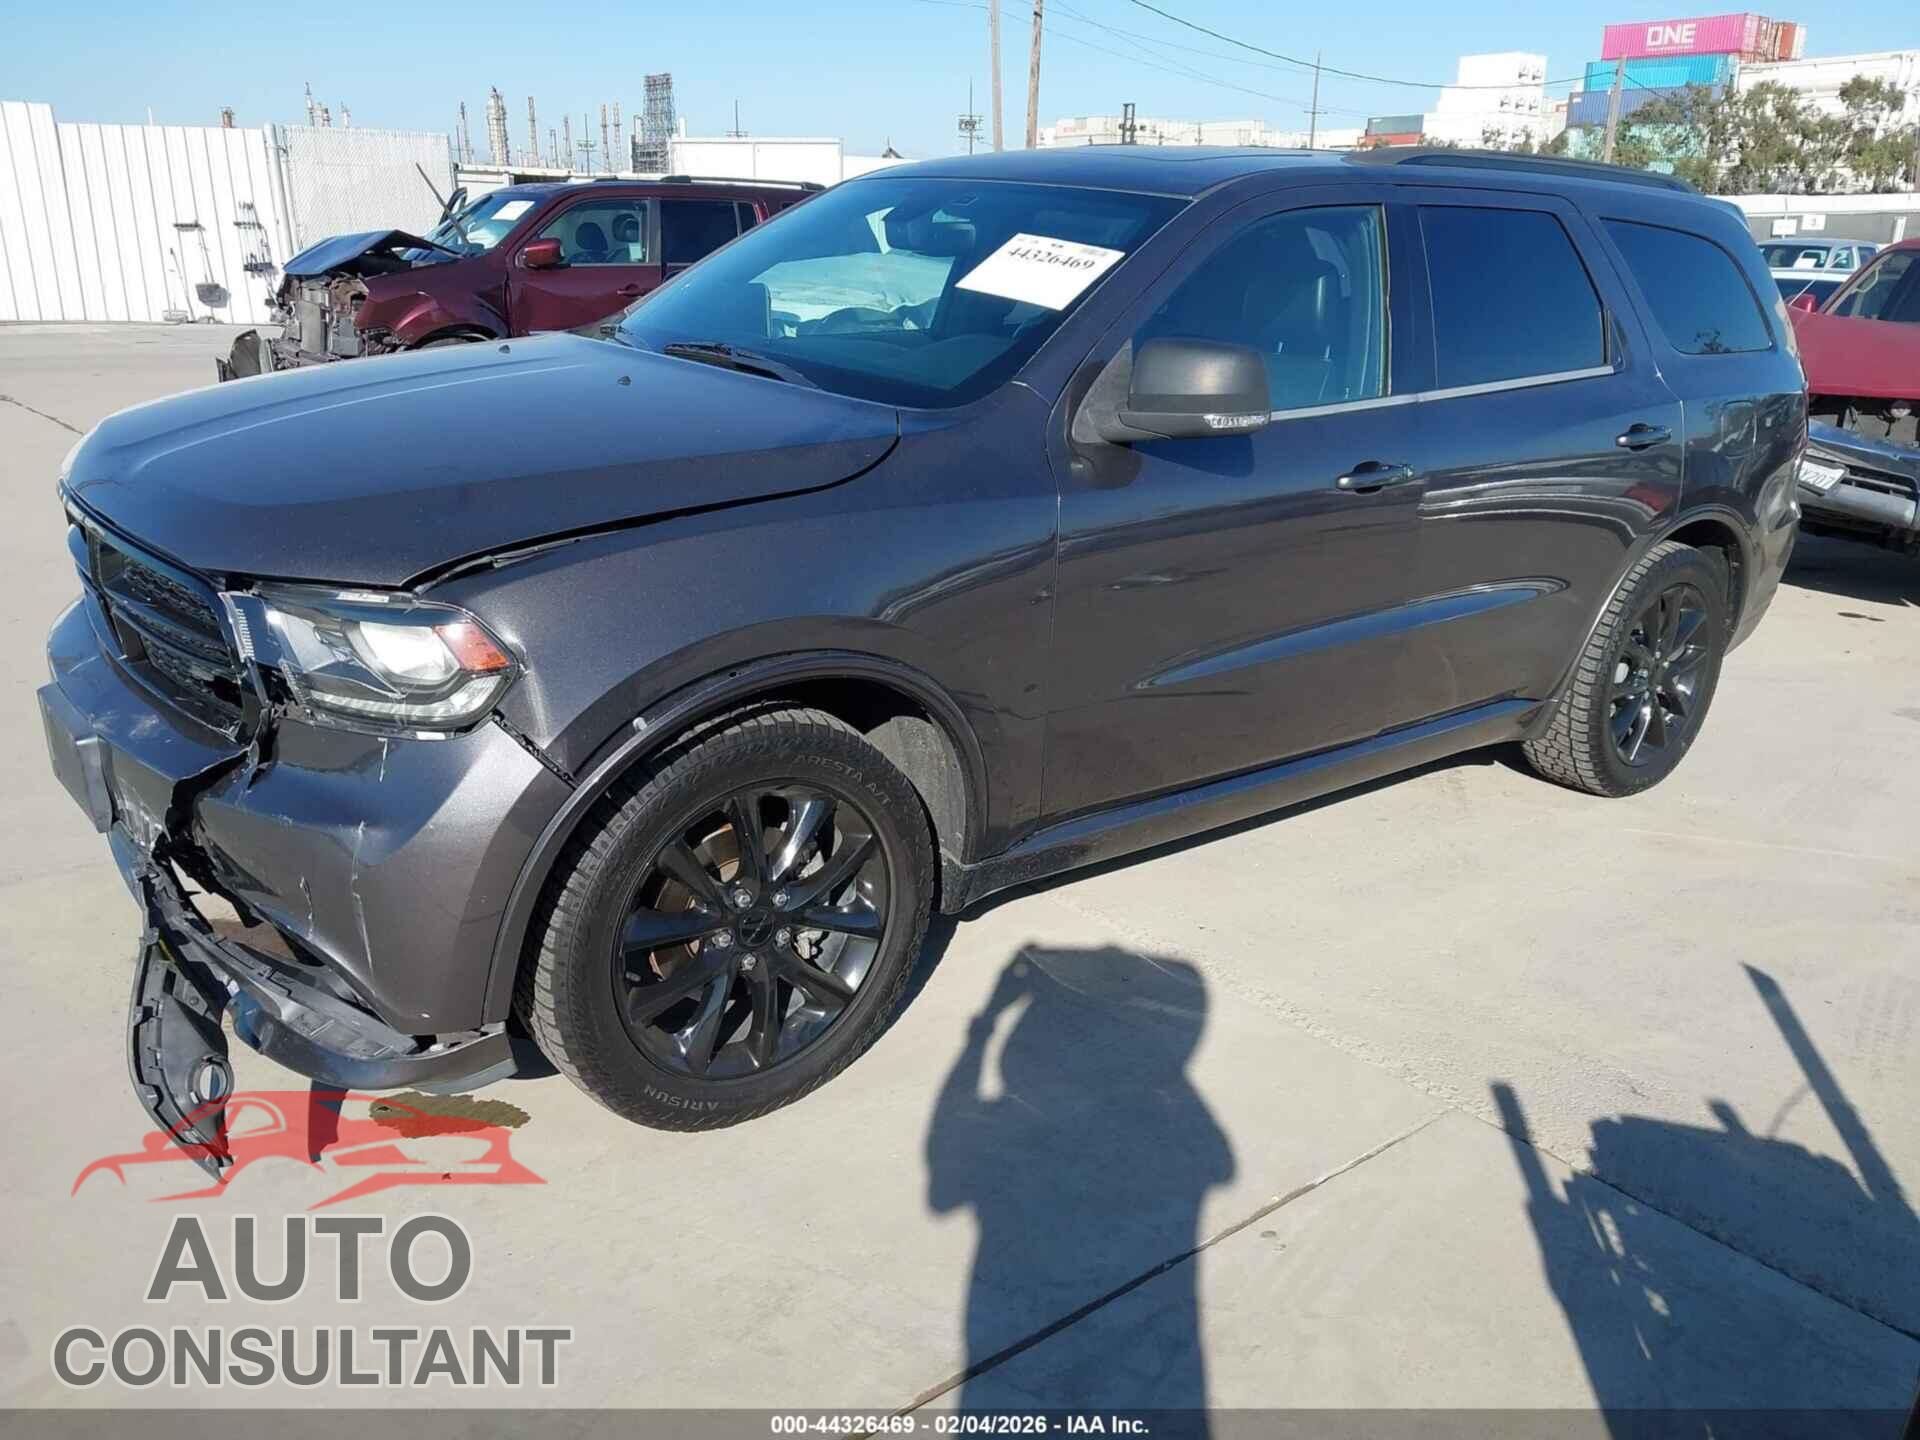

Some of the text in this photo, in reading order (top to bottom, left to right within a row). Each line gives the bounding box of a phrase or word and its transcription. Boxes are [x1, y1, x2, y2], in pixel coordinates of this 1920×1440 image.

[1647, 23, 1697, 46] ONE
[1008, 247, 1096, 269] 44326469
[792, 754, 863, 783] ARESTA
[643, 1084, 719, 1112] ARISUN
